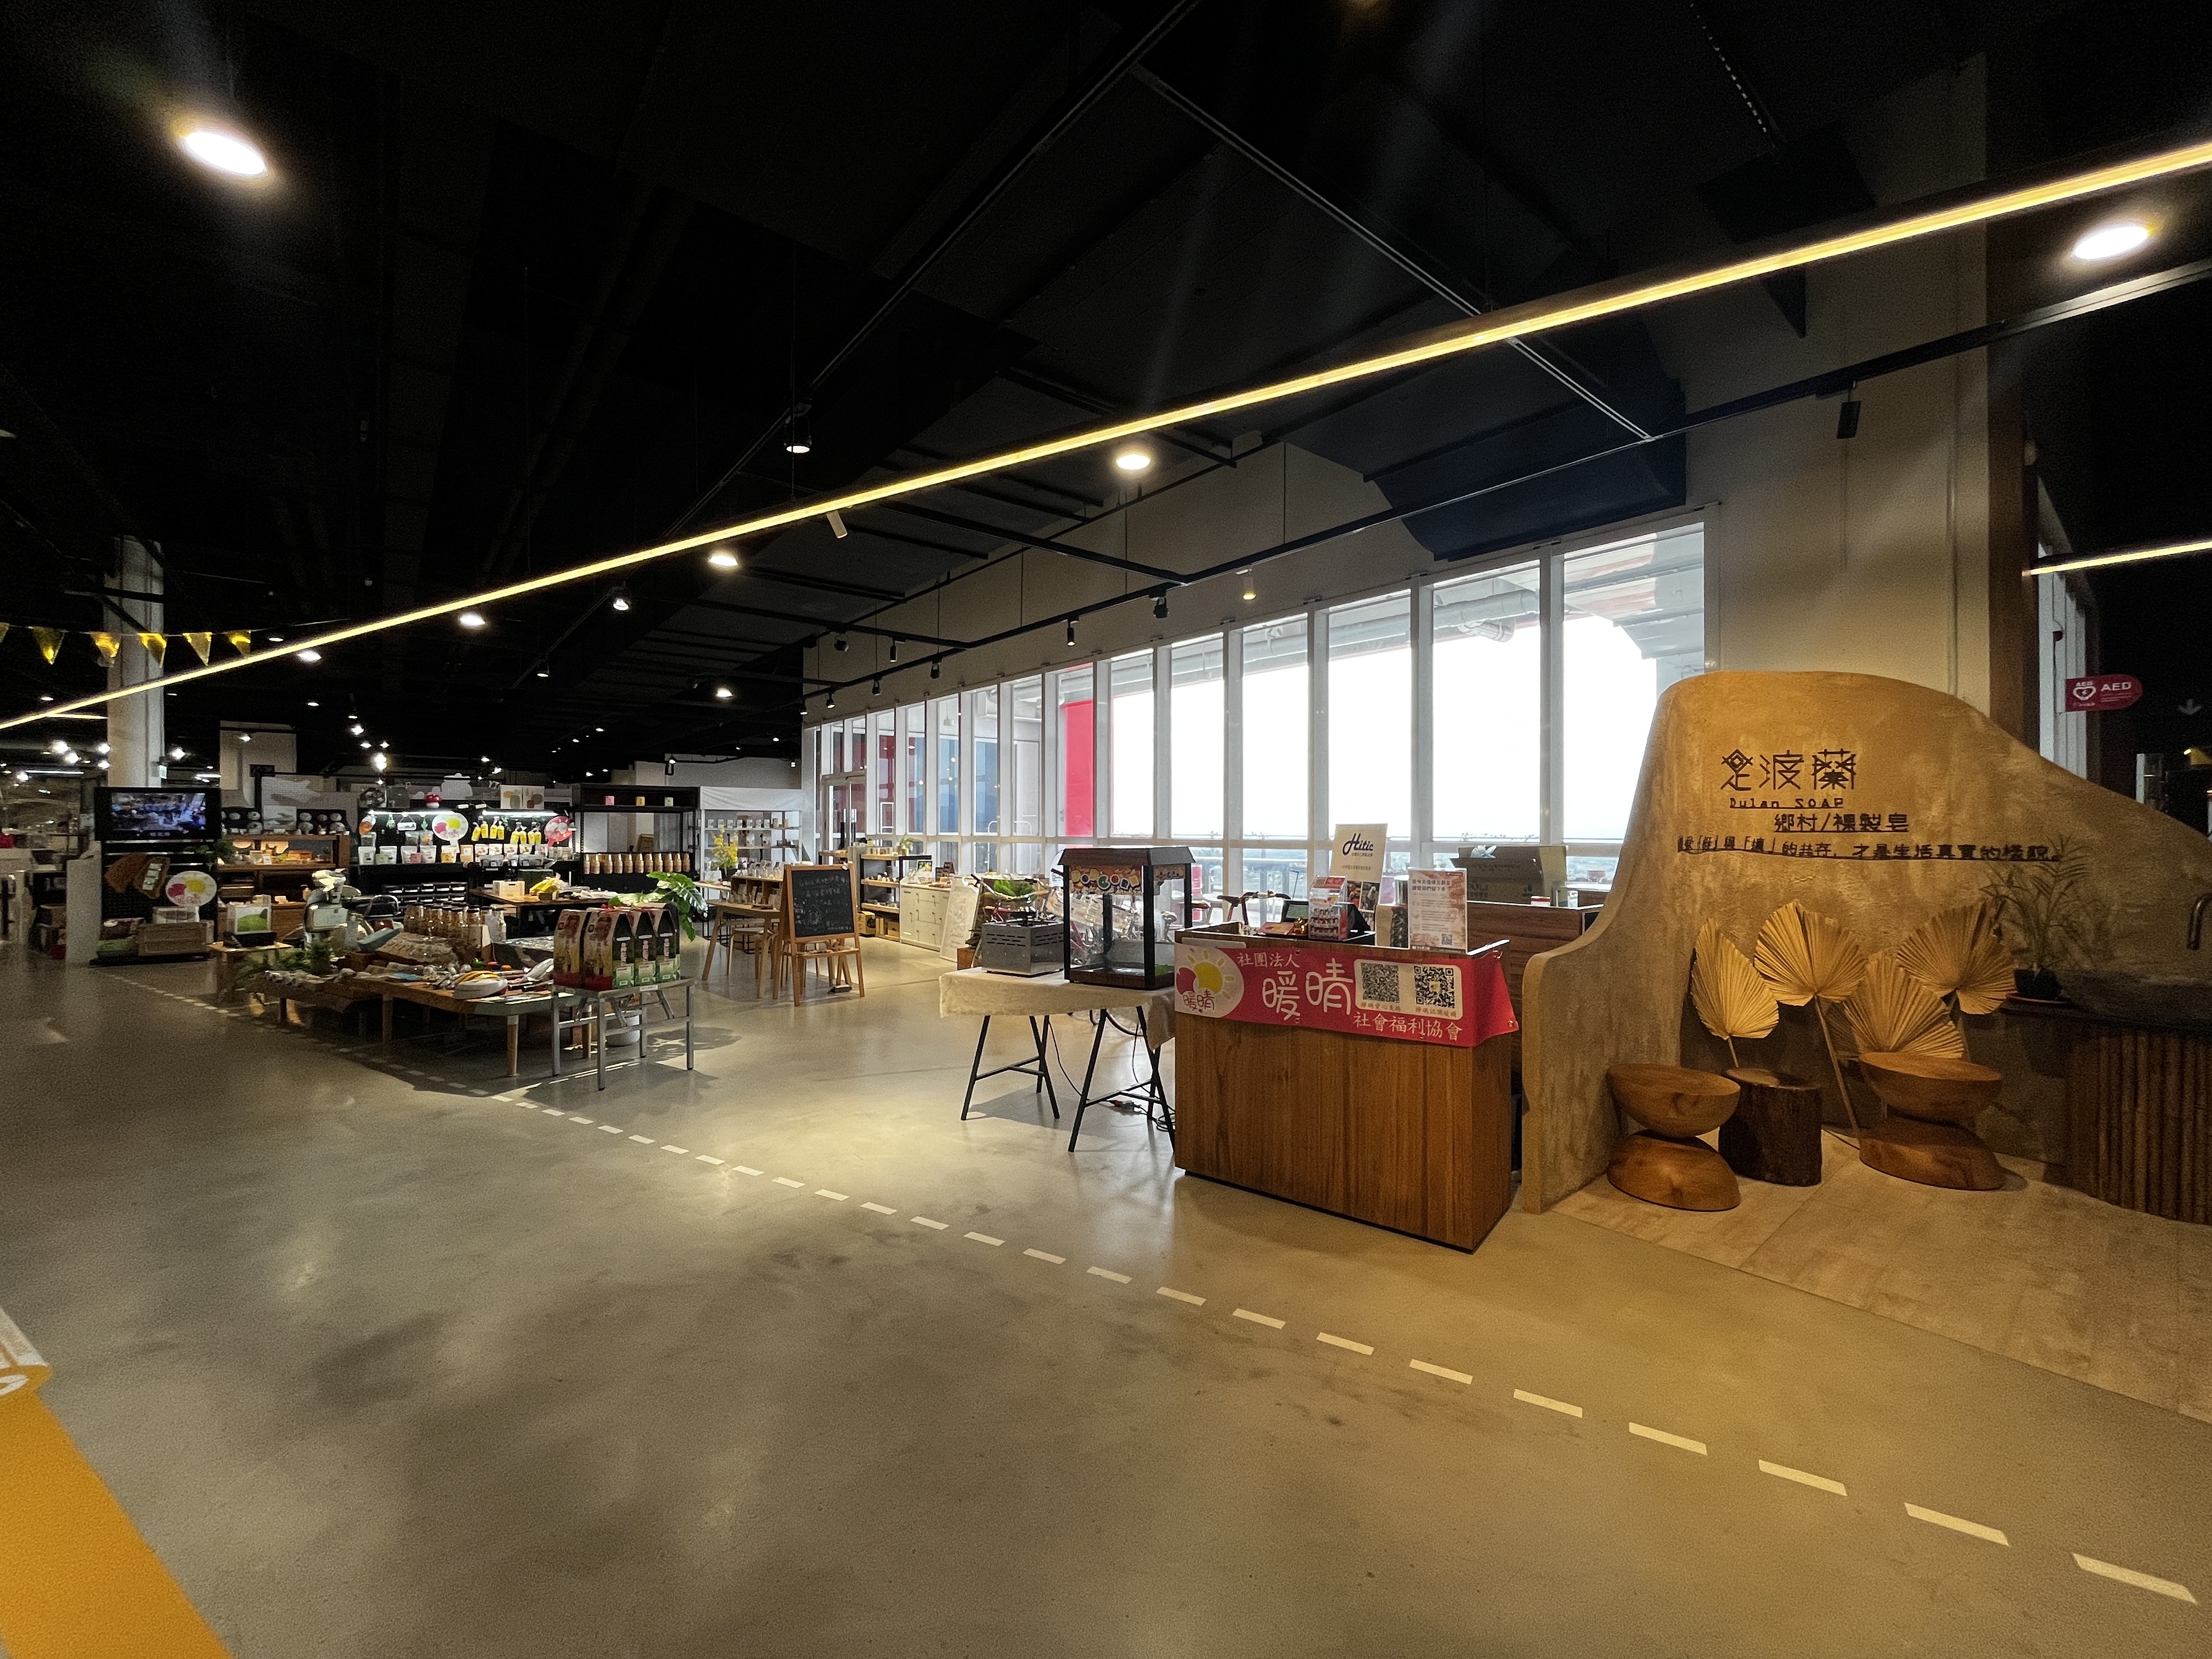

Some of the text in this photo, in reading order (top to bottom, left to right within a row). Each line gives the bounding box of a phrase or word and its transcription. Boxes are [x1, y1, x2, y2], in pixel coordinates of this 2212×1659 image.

[2101, 682, 2132, 691] AED
[1730, 798, 1844, 809] Dulan SOAP
[1237, 952, 1300, 968] 社團法人
[1262, 957, 1353, 1020] 暖晴
[1183, 989, 1215, 1011] 暖晴
[1353, 1012, 1463, 1041] 社會福利協會
